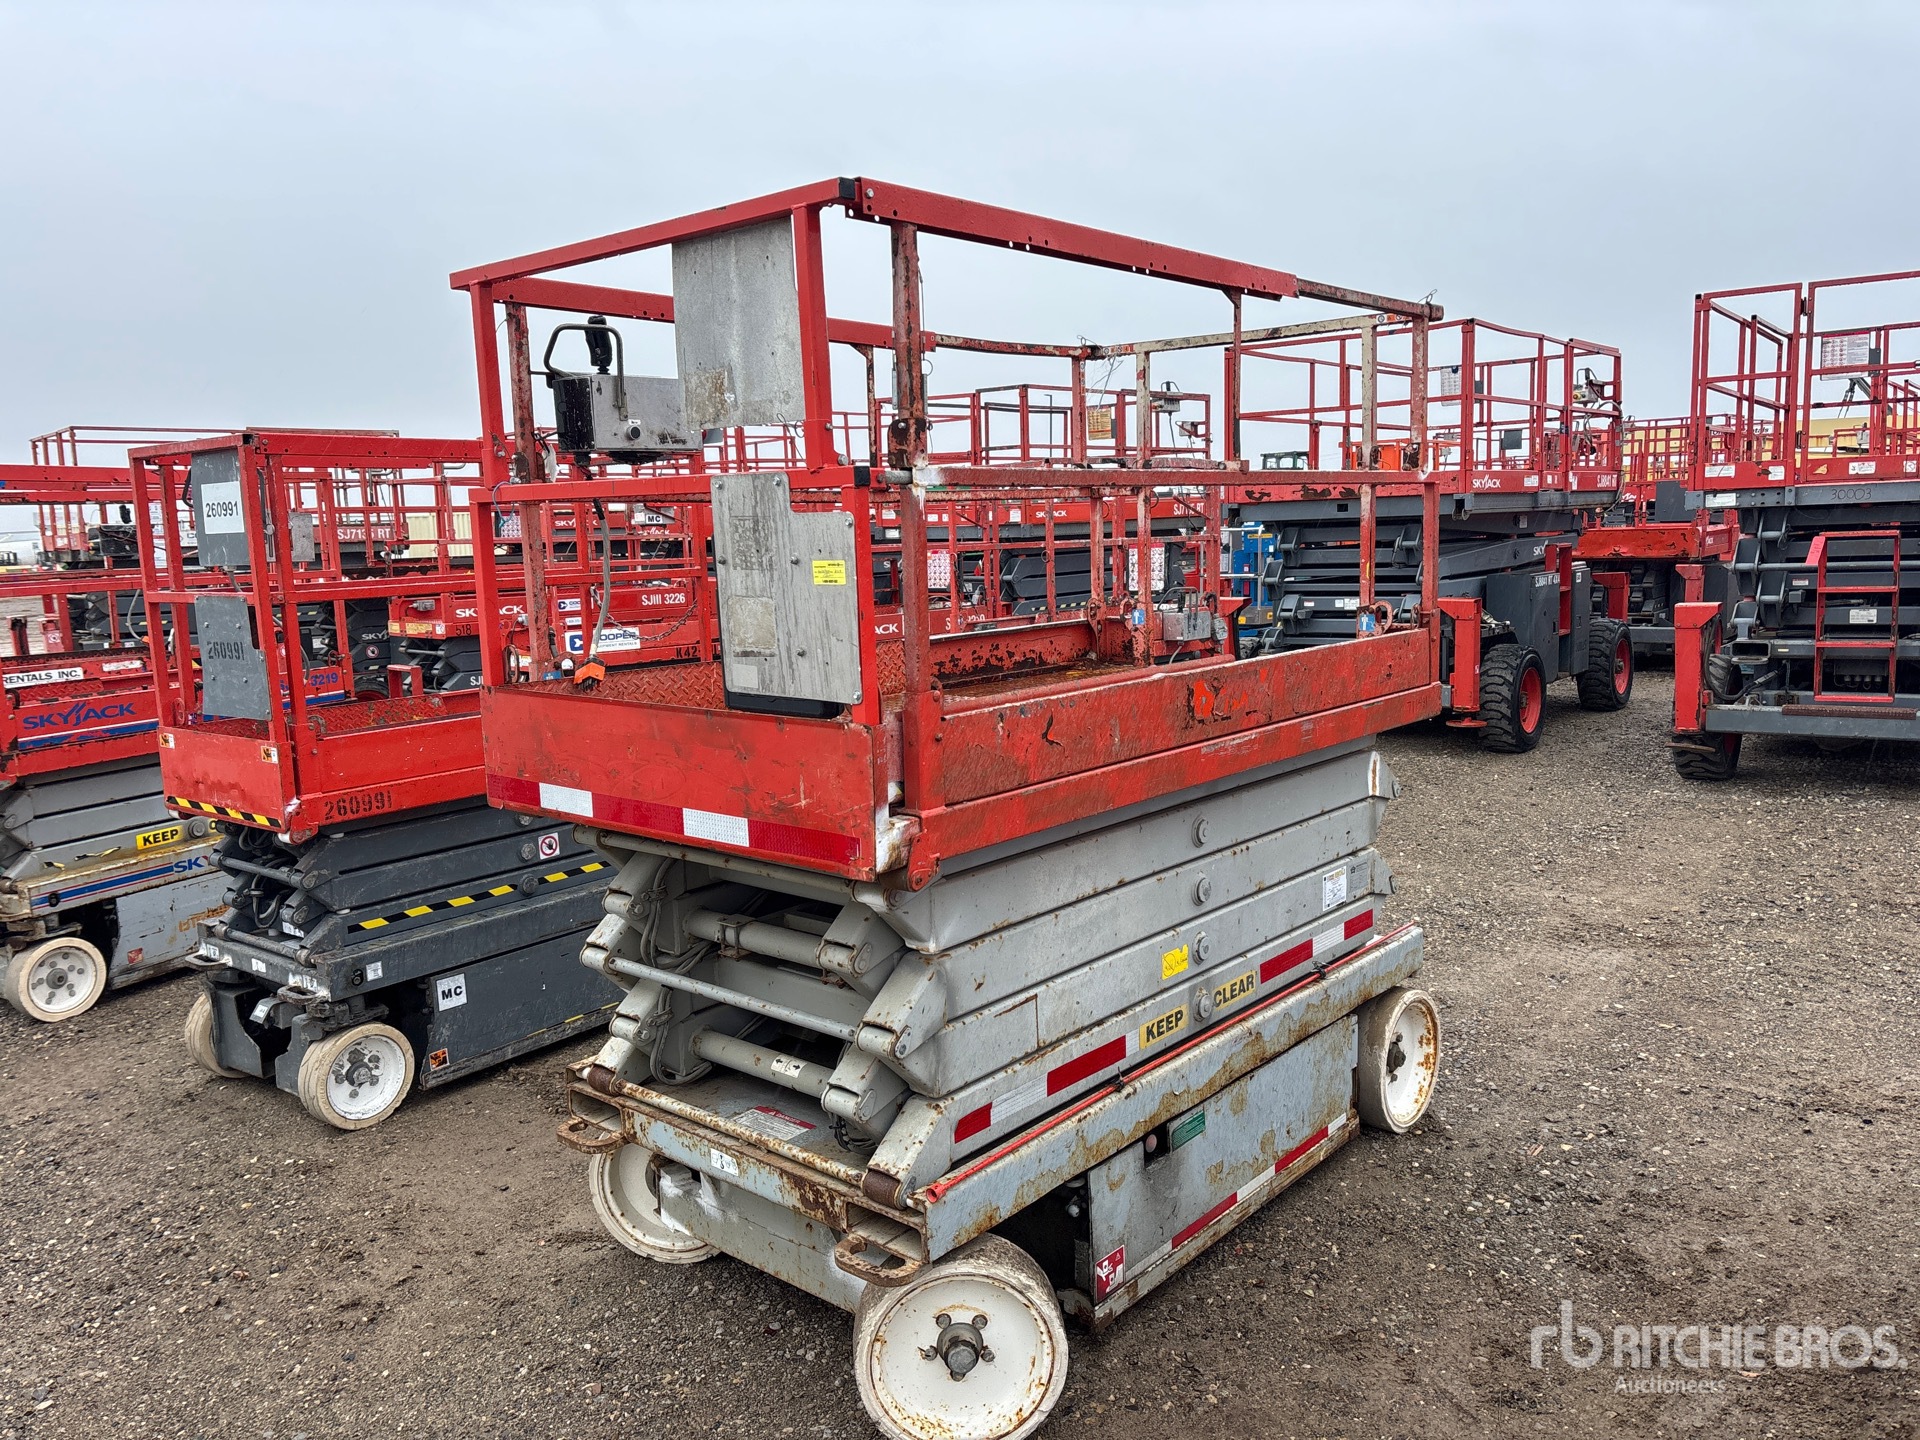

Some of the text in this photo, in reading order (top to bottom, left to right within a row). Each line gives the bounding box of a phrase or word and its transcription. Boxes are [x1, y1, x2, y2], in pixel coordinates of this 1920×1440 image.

[1472, 474, 1501, 490] SKYJACK
[1831, 488, 1872, 501] 30003
[205, 501, 239, 518] 260991
[1035, 510, 1068, 518] SKACK
[647, 515, 661, 523] MC
[377, 528, 391, 539] RT
[664, 593, 686, 604] 3226
[455, 624, 472, 636] 518
[599, 631, 637, 641] OOPER
[207, 641, 245, 661] 260991
[2, 670, 81, 684] RENTALS INC.
[310, 672, 339, 687] 3219
[22, 702, 136, 730] SKYJACK
[324, 790, 393, 821] 260991
[142, 828, 179, 847] KEEP
[441, 985, 463, 1000] MC
[1145, 974, 1255, 1041] KEEP CLEAR
